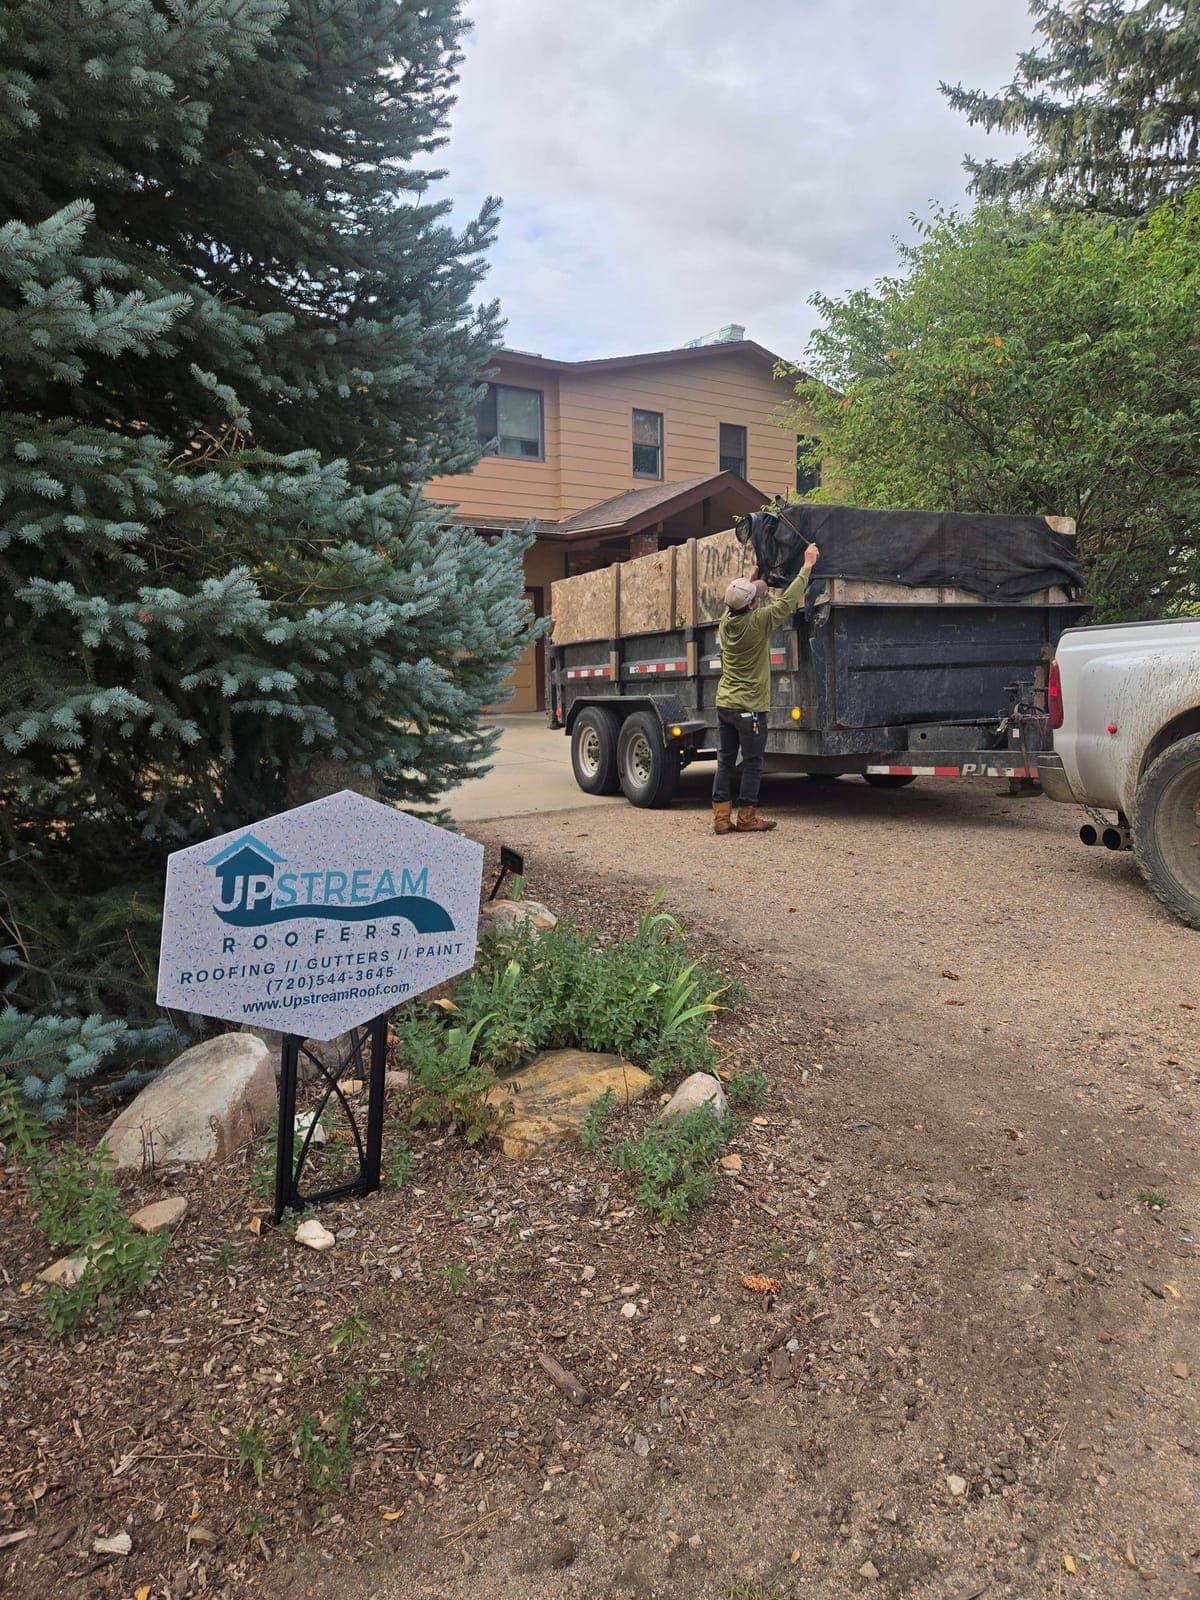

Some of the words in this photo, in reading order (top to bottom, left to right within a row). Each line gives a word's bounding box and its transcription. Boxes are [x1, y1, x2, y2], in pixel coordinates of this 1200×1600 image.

[215, 866, 429, 912] UPSTREAM
[222, 923, 401, 954] ROOFERS
[180, 962, 276, 985] ROOFING
[306, 950, 390, 970] GUTTERS
[416, 943, 463, 959] PAINT
[266, 966, 394, 995] (720)544-3645
[242, 982, 410, 1013] www.UpstreamRoof.com
